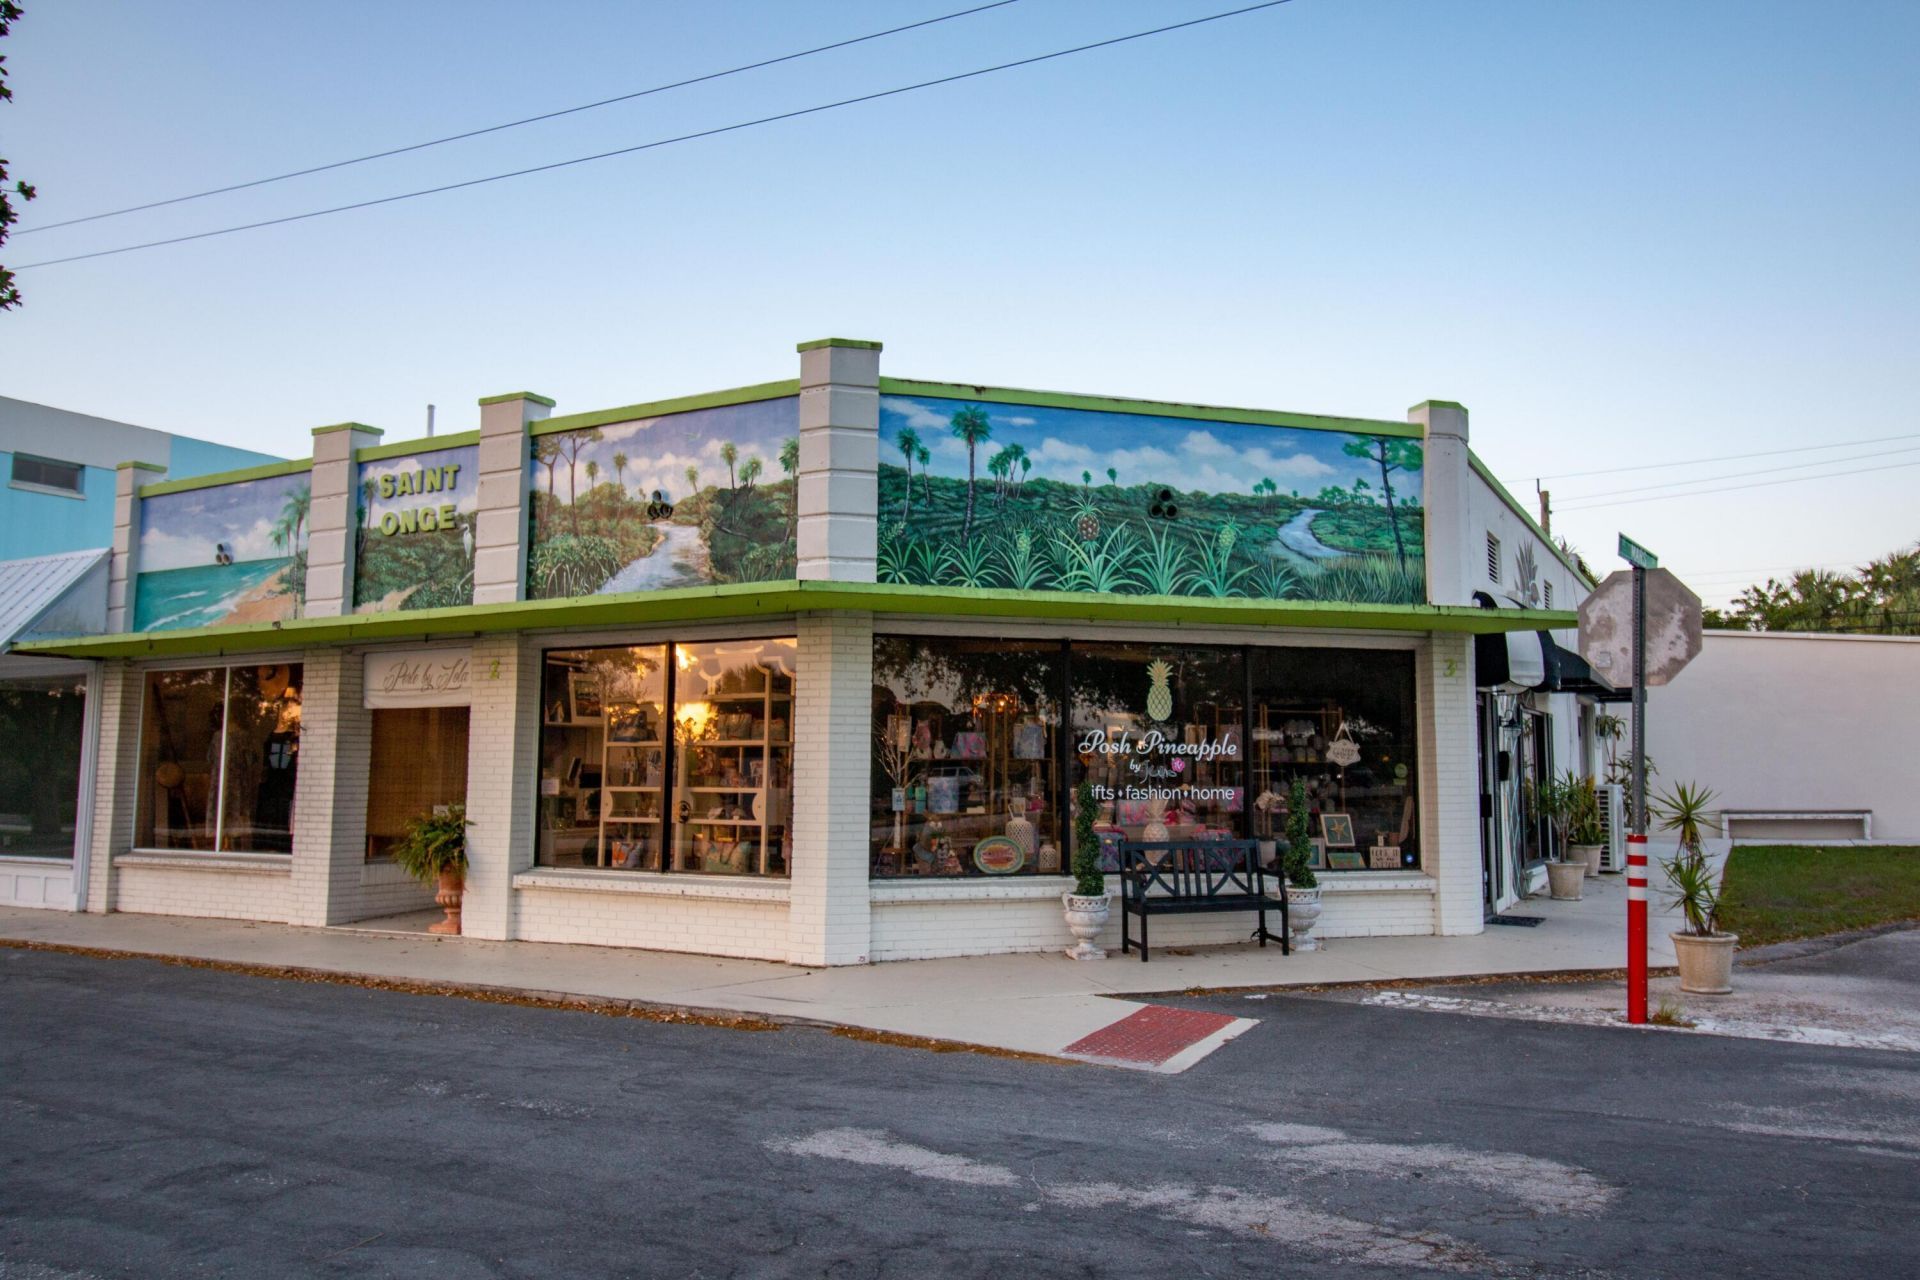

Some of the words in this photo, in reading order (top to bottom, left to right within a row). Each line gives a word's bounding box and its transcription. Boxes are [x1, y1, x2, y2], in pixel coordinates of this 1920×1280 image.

[379, 463, 461, 499] SAINT
[380, 504, 457, 536] ONGE
[420, 663, 434, 693] by
[1078, 729, 1131, 755] Posh
[1136, 730, 1237, 762] Pineapple
[1129, 759, 1141, 773] by
[1091, 785, 1115, 800] ifts
[1125, 784, 1181, 800] fashion
[1190, 785, 1235, 800] home
